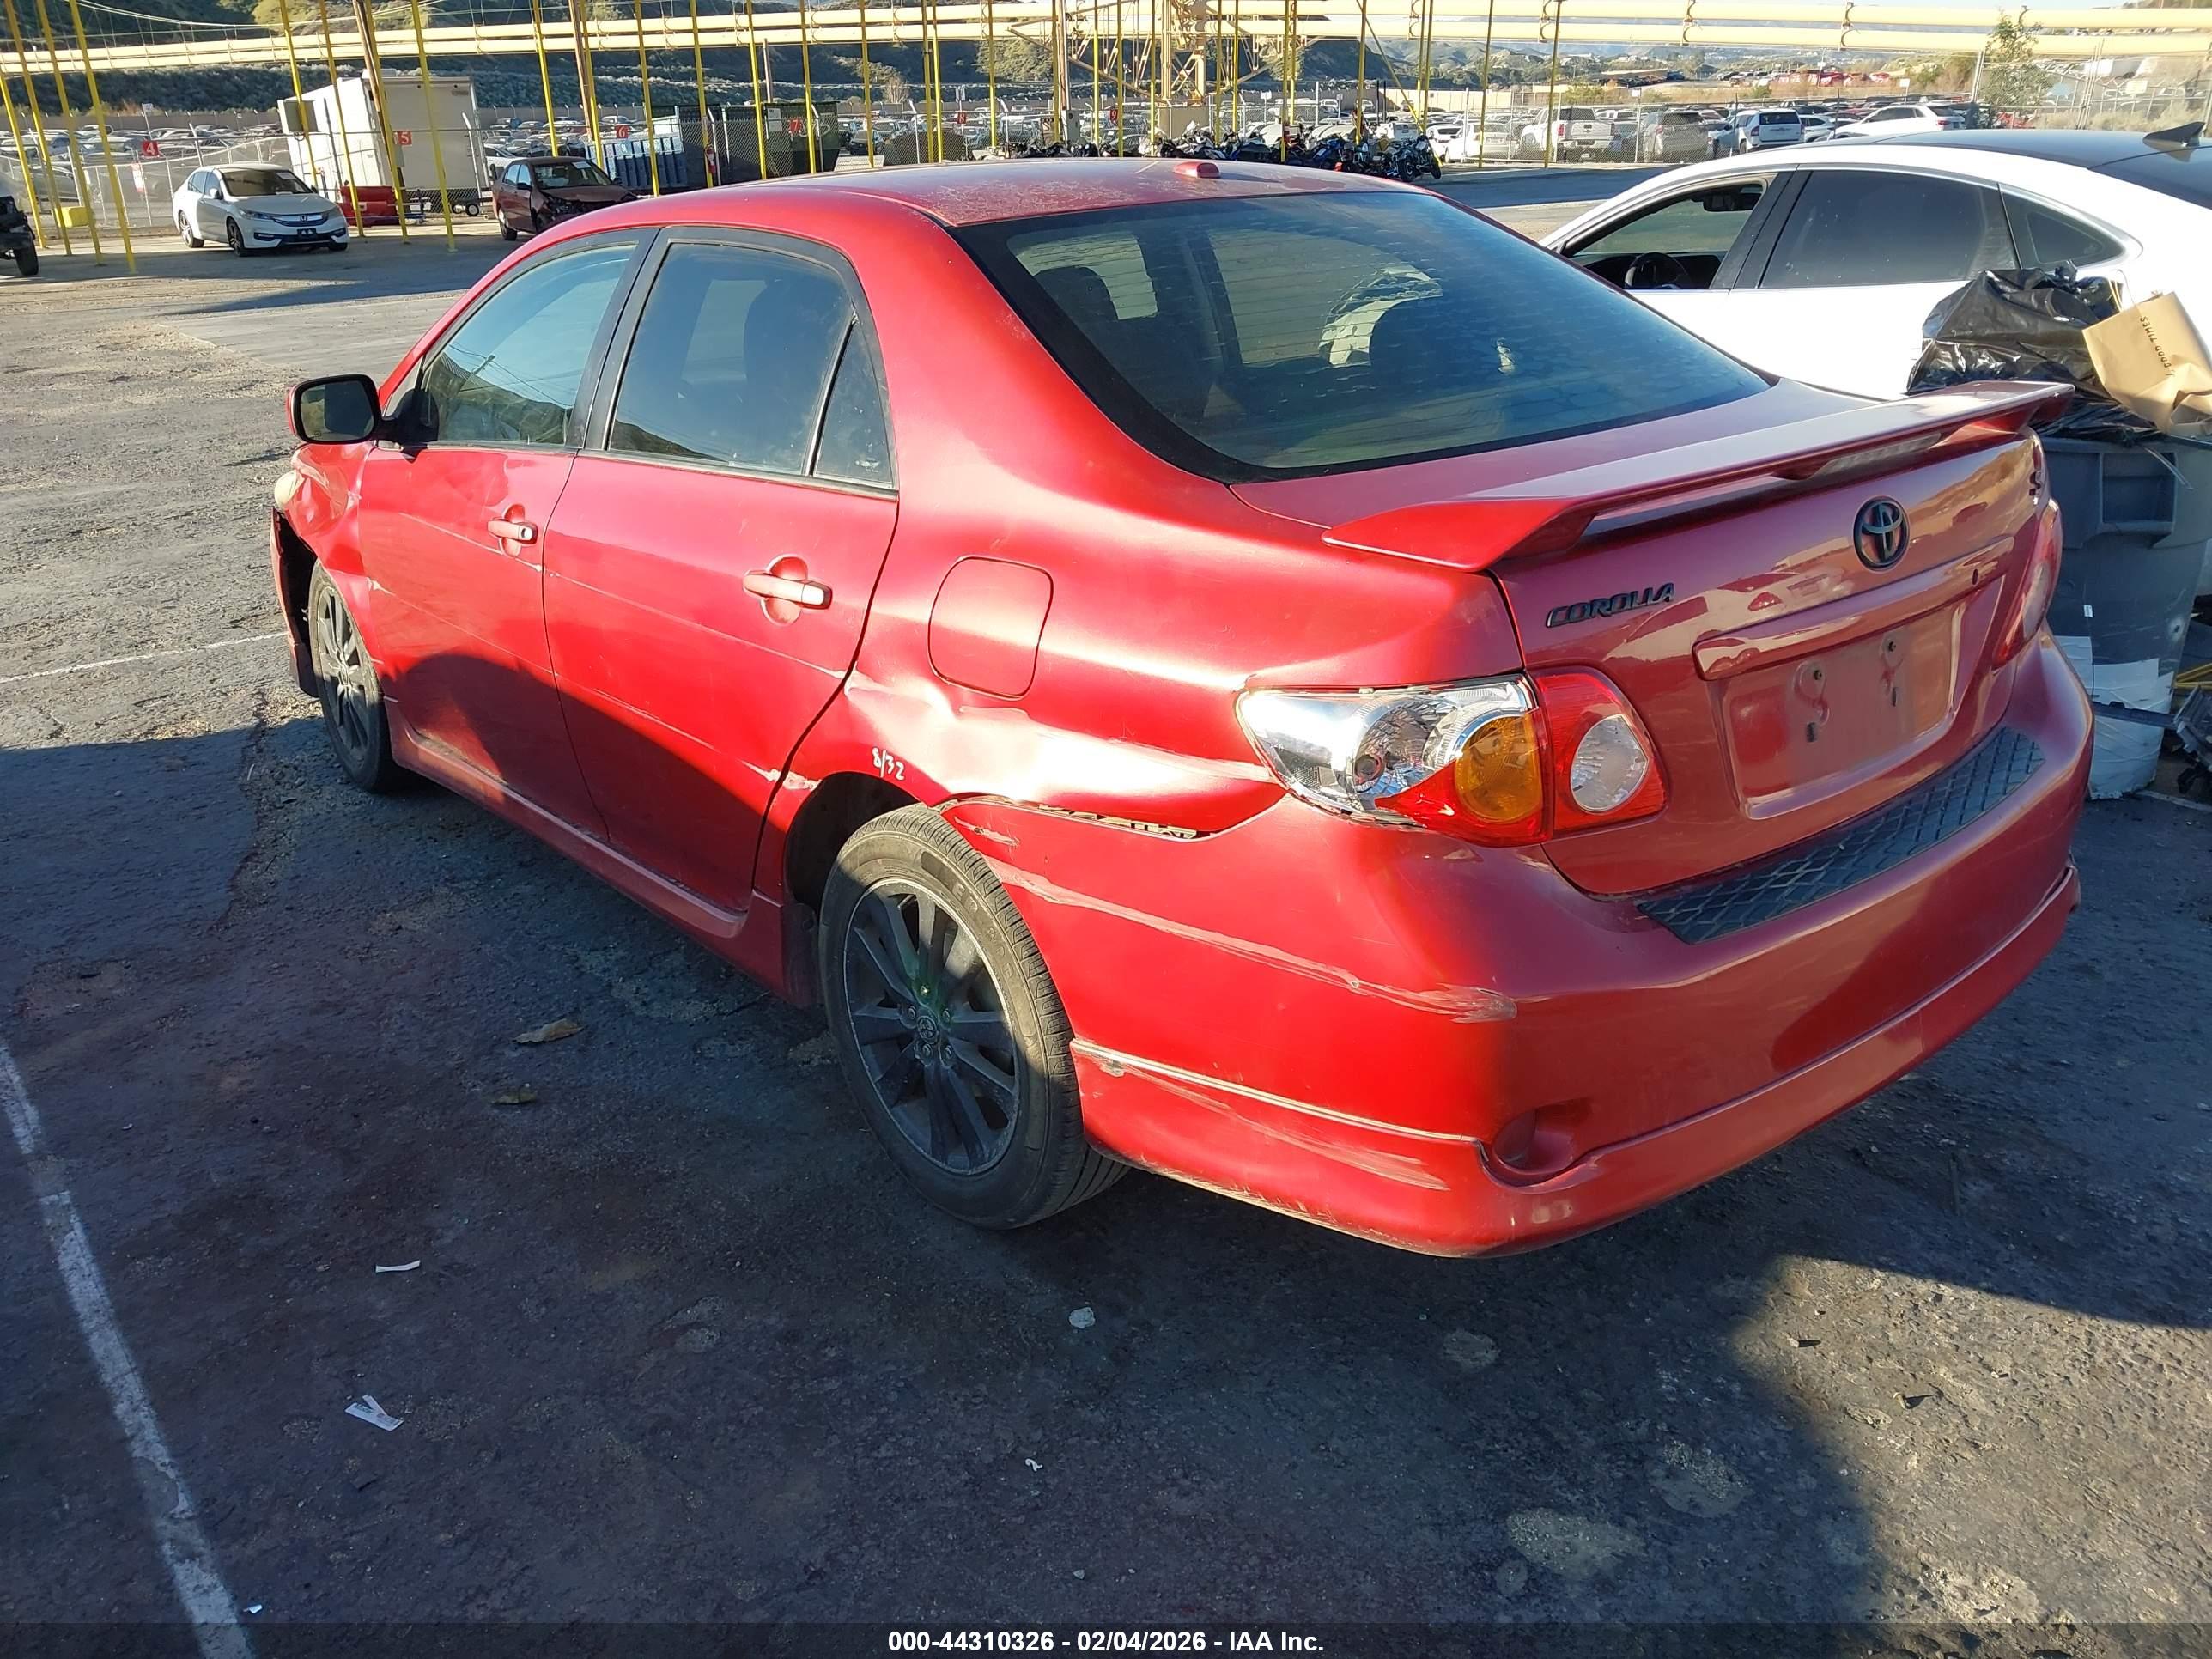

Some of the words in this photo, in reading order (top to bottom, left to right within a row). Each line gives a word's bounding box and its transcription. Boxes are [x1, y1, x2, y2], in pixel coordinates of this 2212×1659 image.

[618, 126, 627, 138] 6
[146, 142, 155, 155] 4
[2139, 315, 2158, 343] TIMES
[2154, 345, 2172, 368] GOOD
[1545, 582, 1674, 629] COROLLA
[872, 746, 905, 781] 8/32
